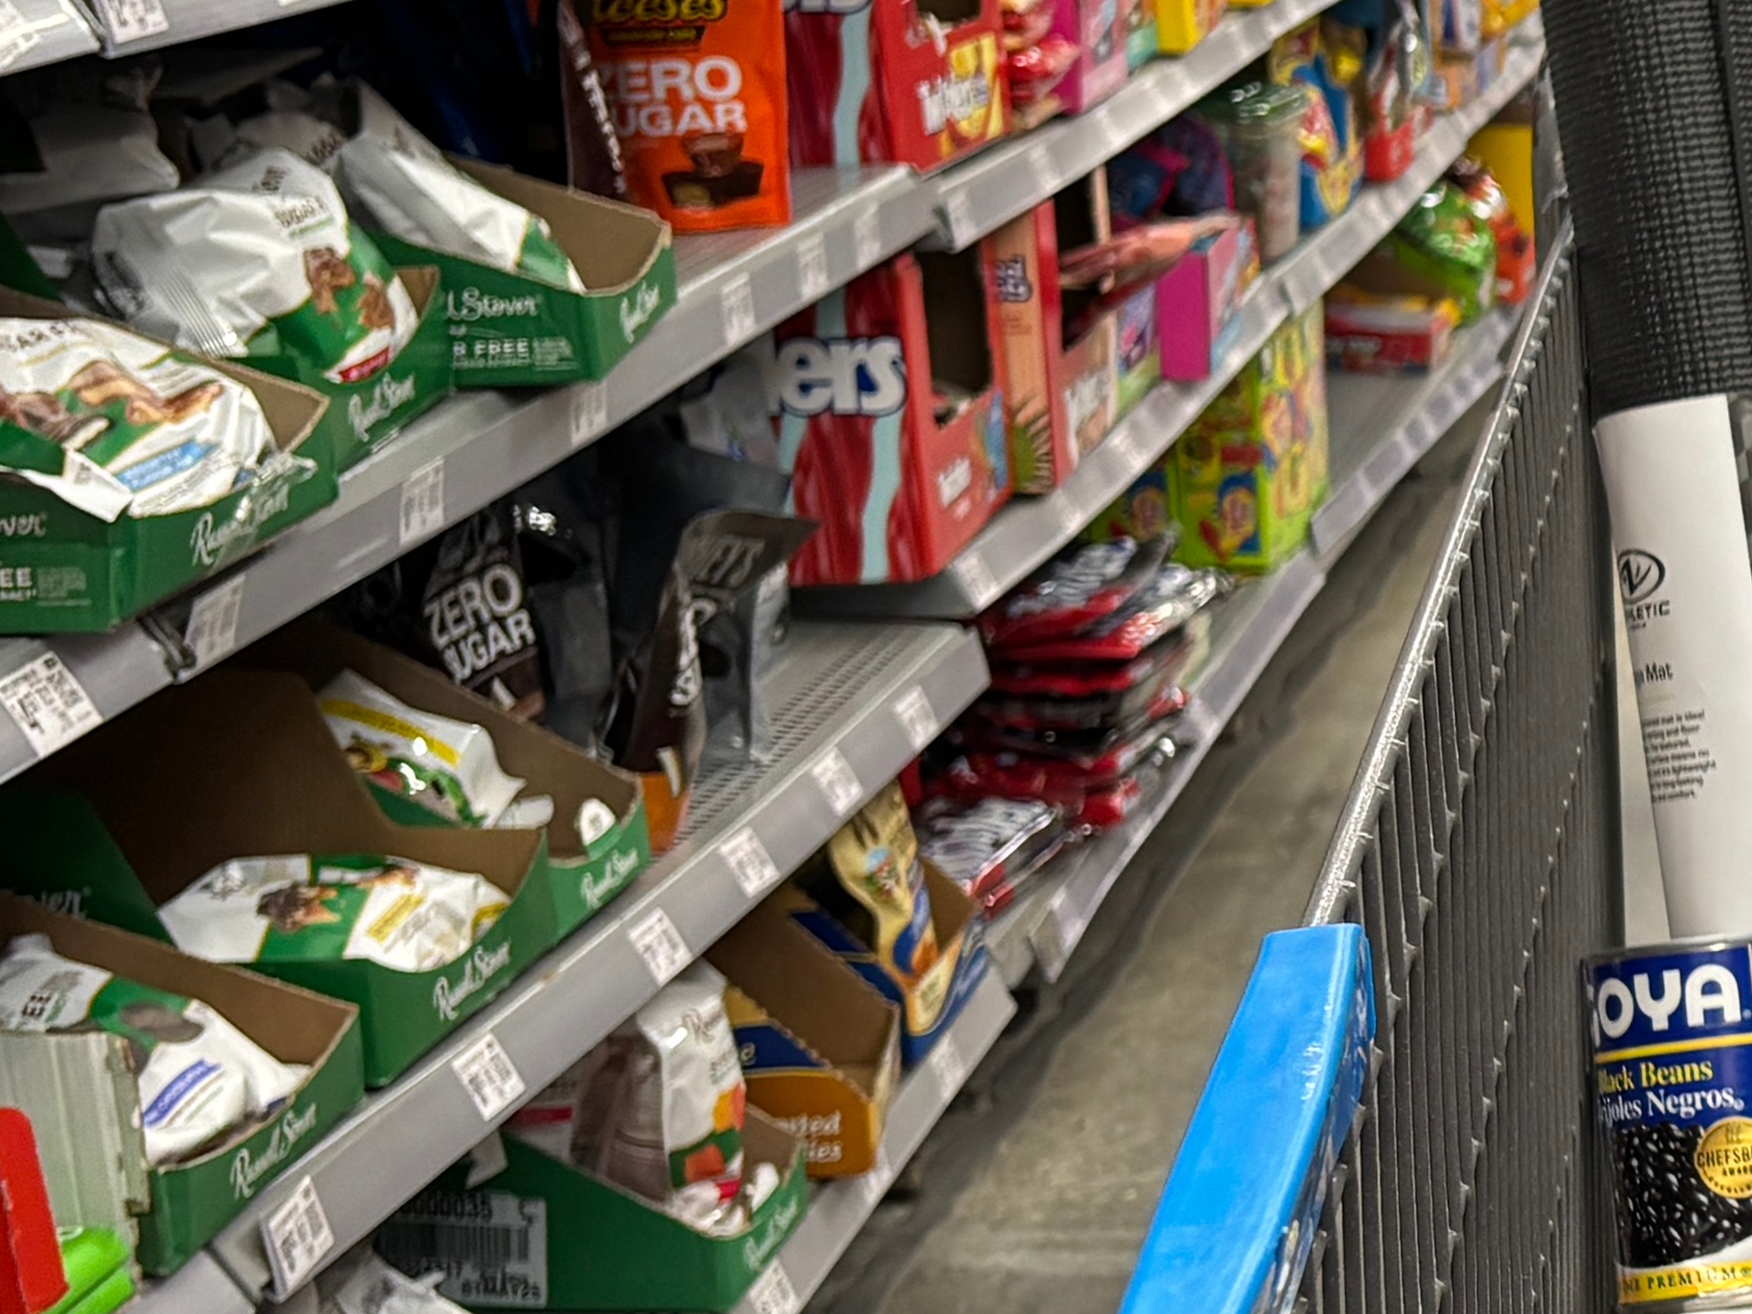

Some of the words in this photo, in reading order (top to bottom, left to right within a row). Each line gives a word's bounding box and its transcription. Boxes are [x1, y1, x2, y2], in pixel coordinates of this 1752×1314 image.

[421, 562, 522, 649] ZERO
[1595, 963, 1743, 1040] OYA
[1639, 1060, 1713, 1086] Beans
